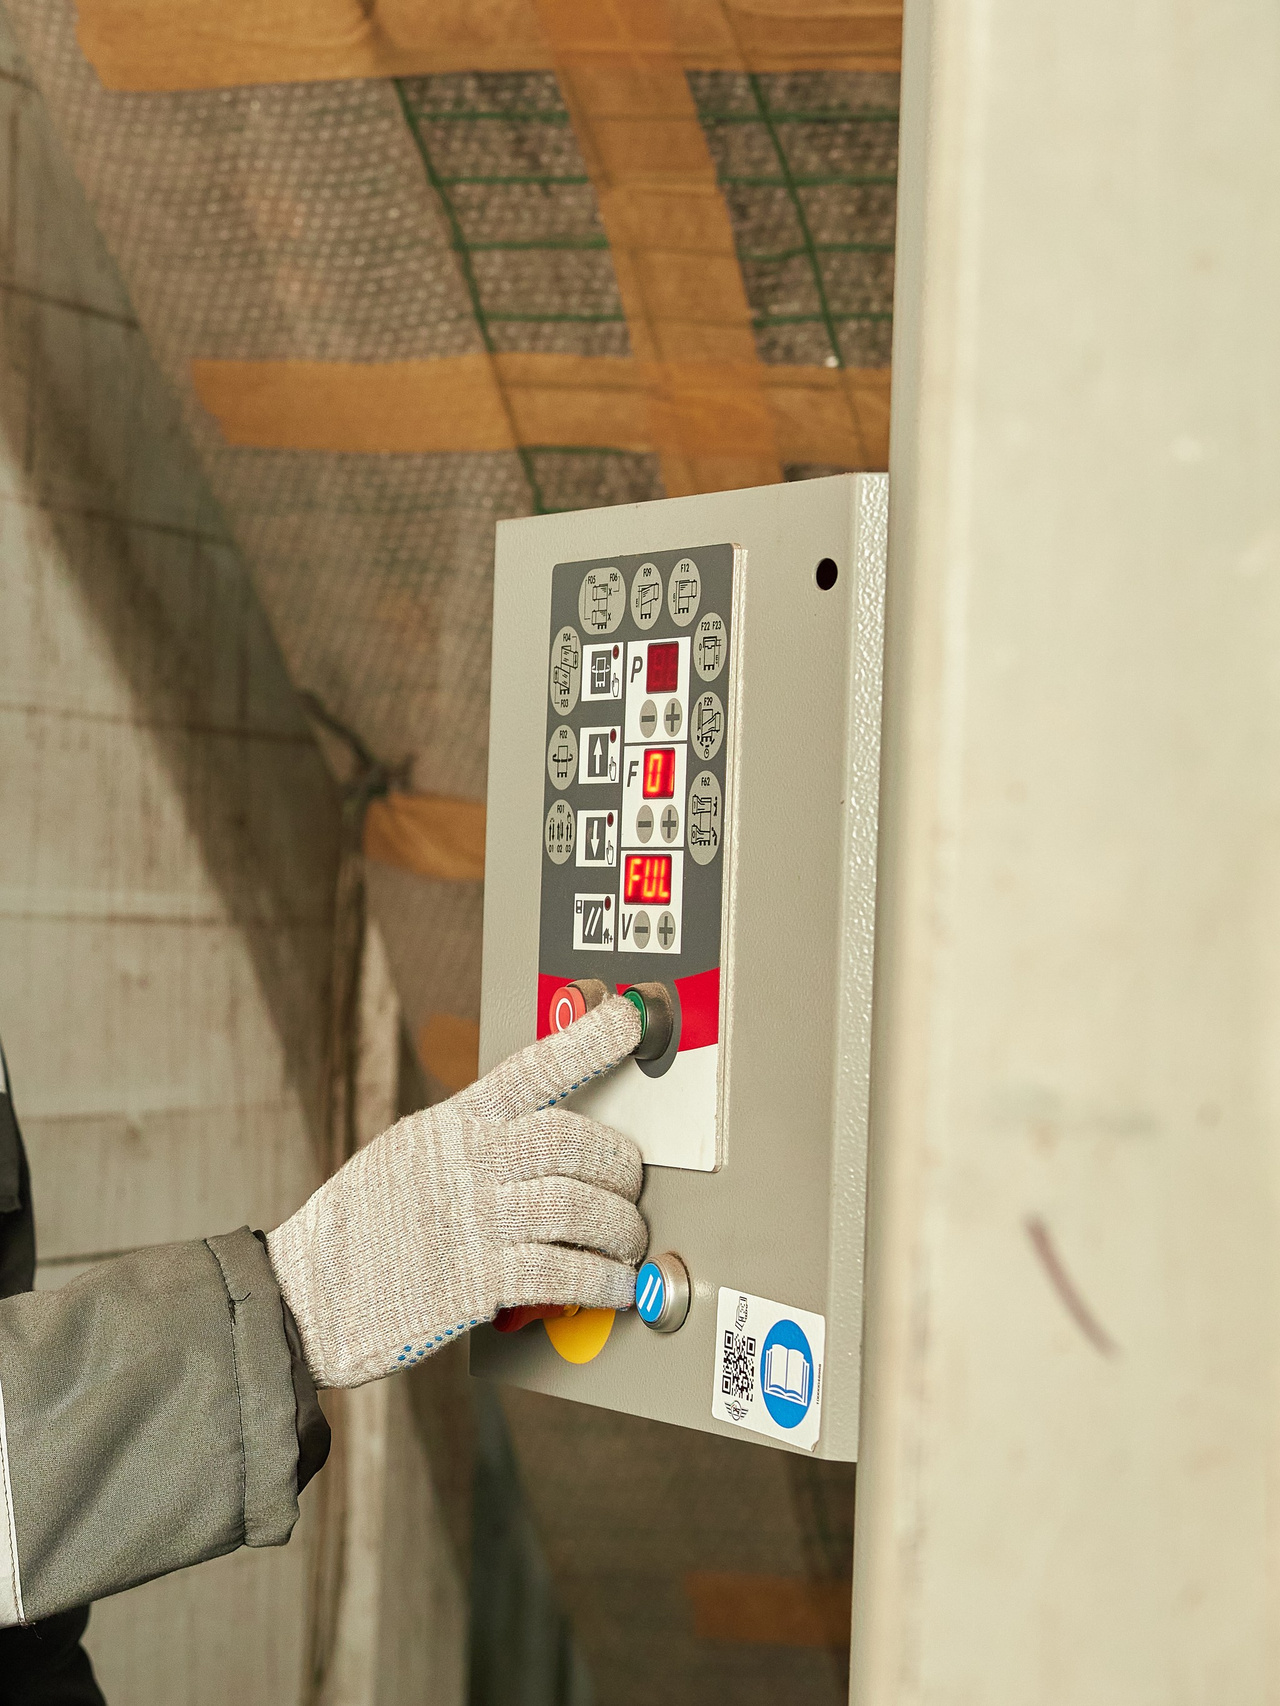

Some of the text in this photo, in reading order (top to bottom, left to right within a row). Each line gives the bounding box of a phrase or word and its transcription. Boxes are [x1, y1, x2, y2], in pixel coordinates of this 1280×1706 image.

[642, 567, 652, 577] F09
[680, 563, 690, 573] F12
[587, 575, 596, 585] F05
[609, 573, 618, 582] F06
[700, 620, 722, 631] F22 F23
[630, 655, 643, 684] P
[703, 697, 713, 707] F29
[559, 729, 568, 739] F02
[626, 760, 640, 788] F
[701, 776, 711, 787] F62
[556, 804, 565, 814] F01
[621, 913, 633, 941] V
